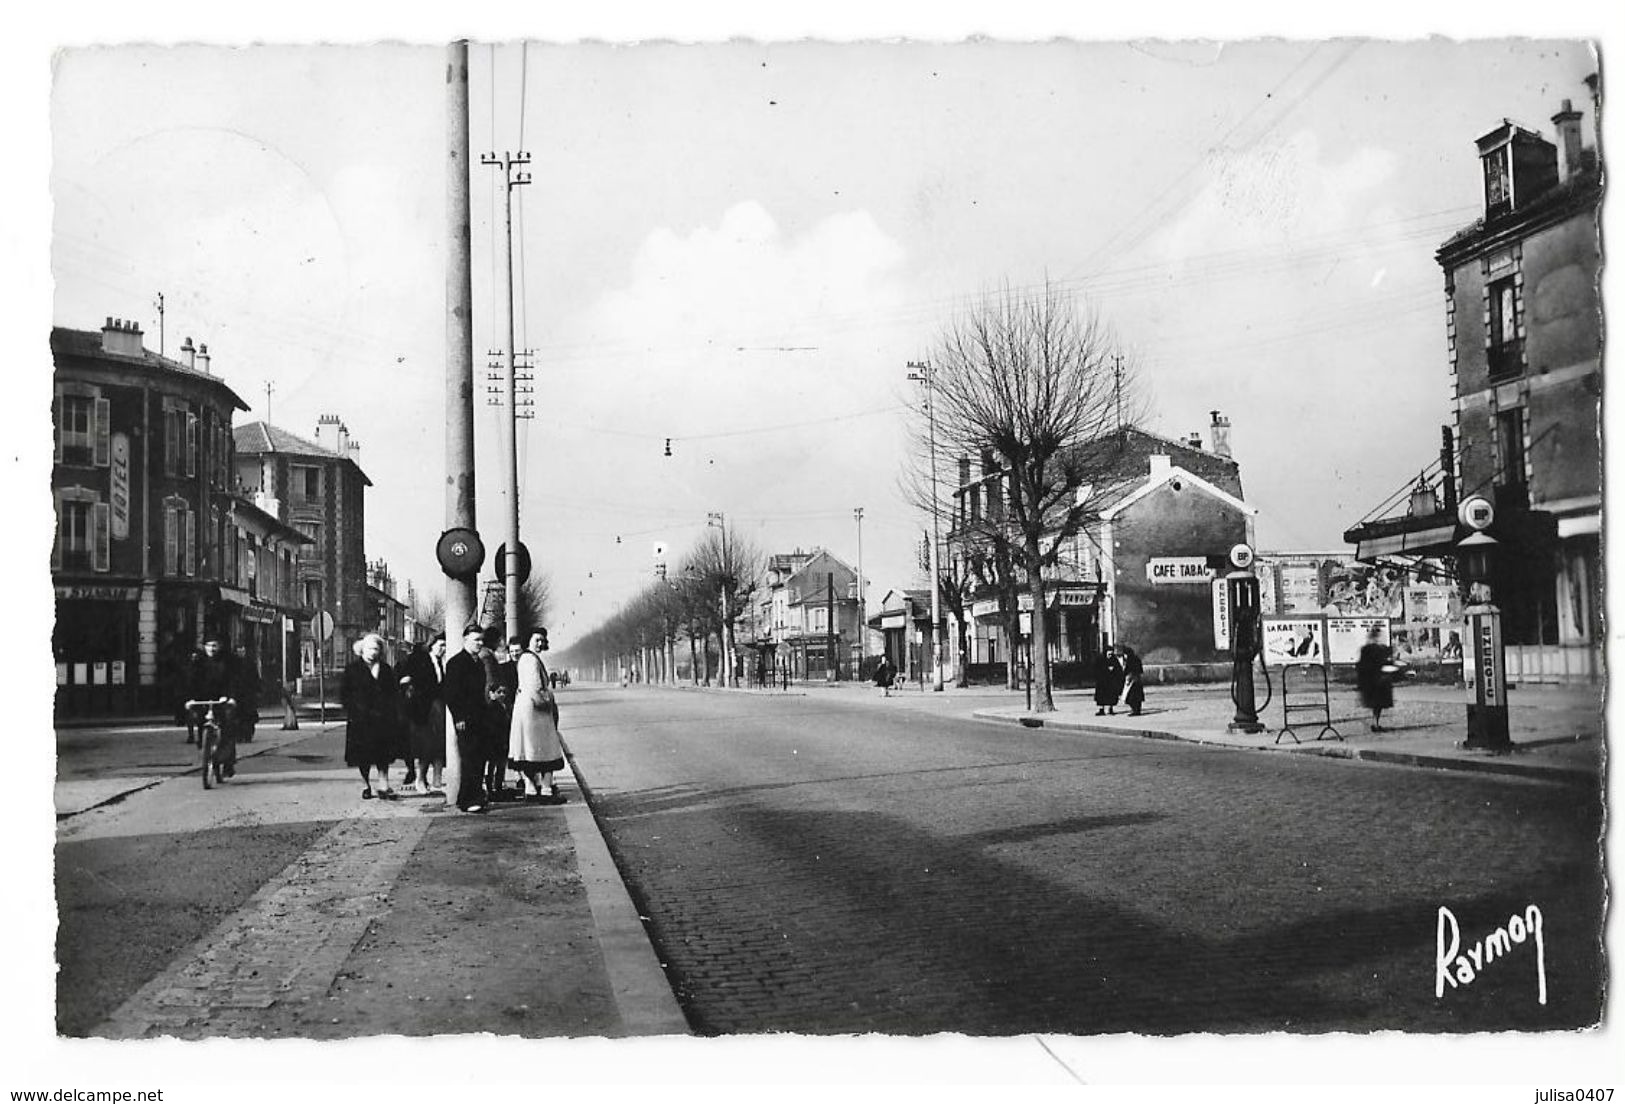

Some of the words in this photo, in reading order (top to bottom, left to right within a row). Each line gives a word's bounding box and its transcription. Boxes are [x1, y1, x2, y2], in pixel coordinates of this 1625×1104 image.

[114, 457, 127, 522] HOTEL
[1474, 508, 1489, 520] BP
[1237, 552, 1249, 561] BP
[1180, 564, 1210, 577] TABAC
[1482, 626, 1494, 698] ENERGIC
